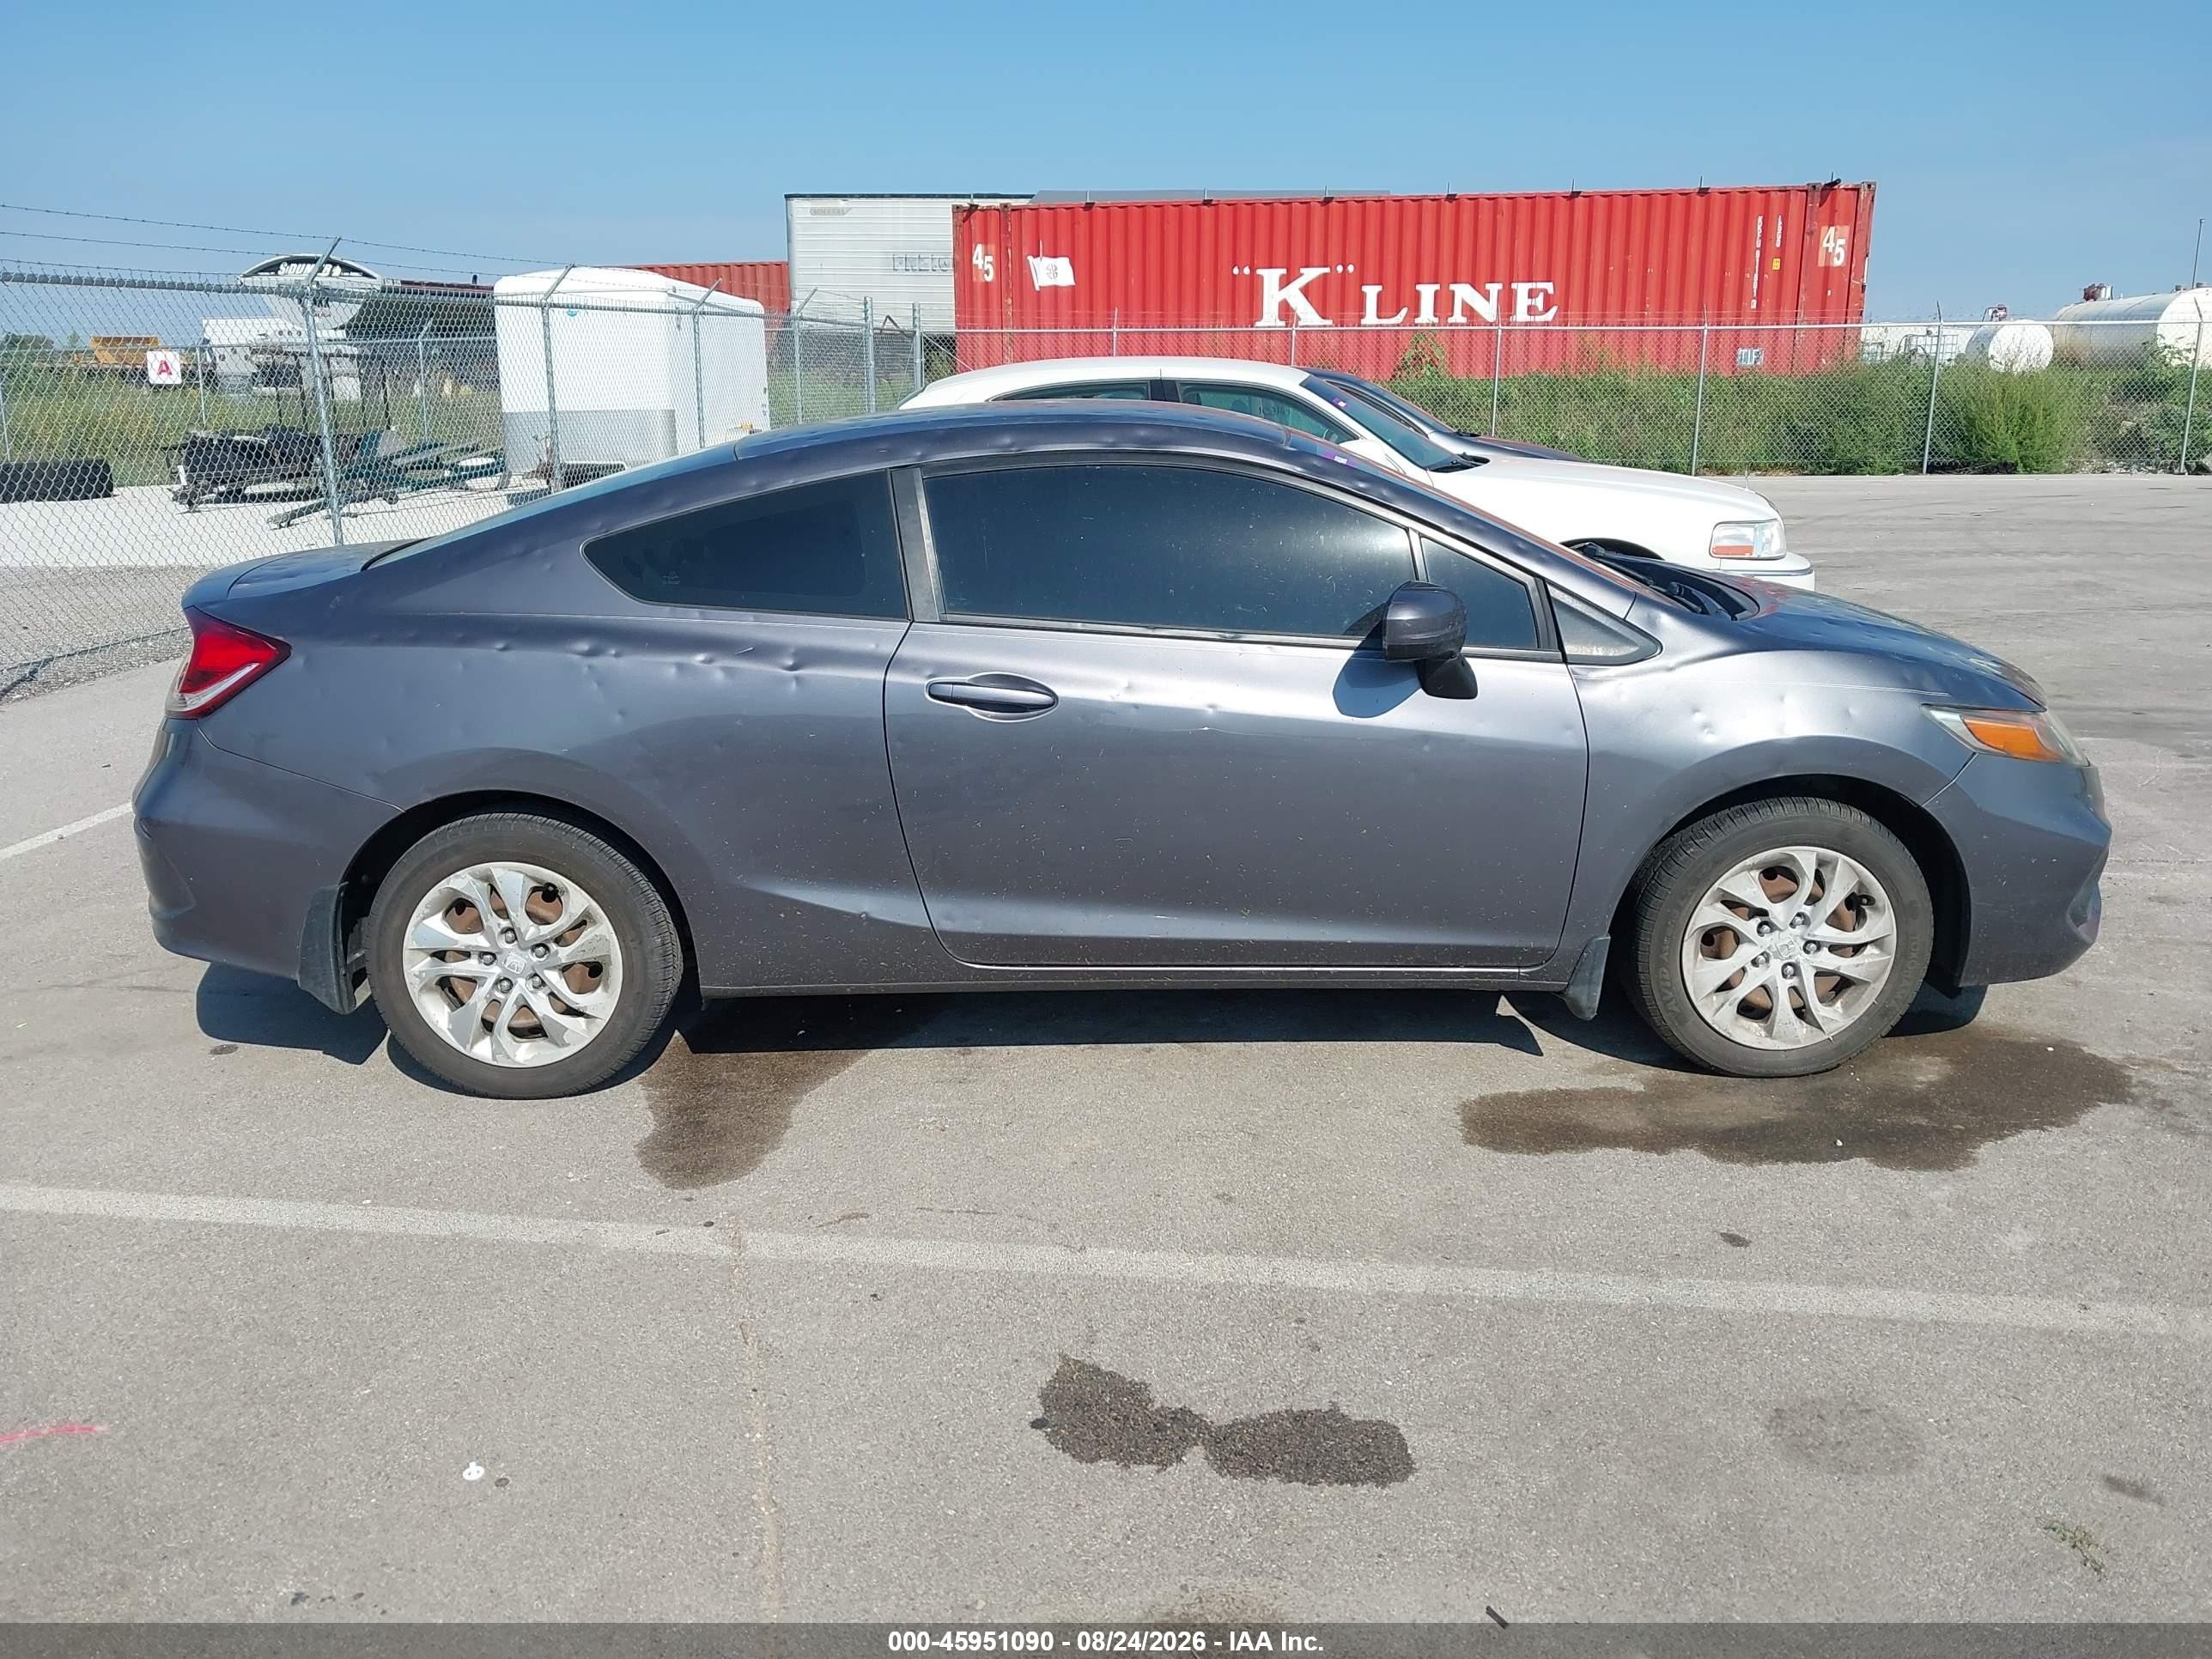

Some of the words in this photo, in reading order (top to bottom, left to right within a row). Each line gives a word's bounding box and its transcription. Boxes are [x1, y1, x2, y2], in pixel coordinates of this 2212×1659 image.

[972, 243, 994, 283] 45
[1822, 226, 1846, 267] 45
[1360, 281, 1559, 325] LINE
[156, 359, 173, 376] A
